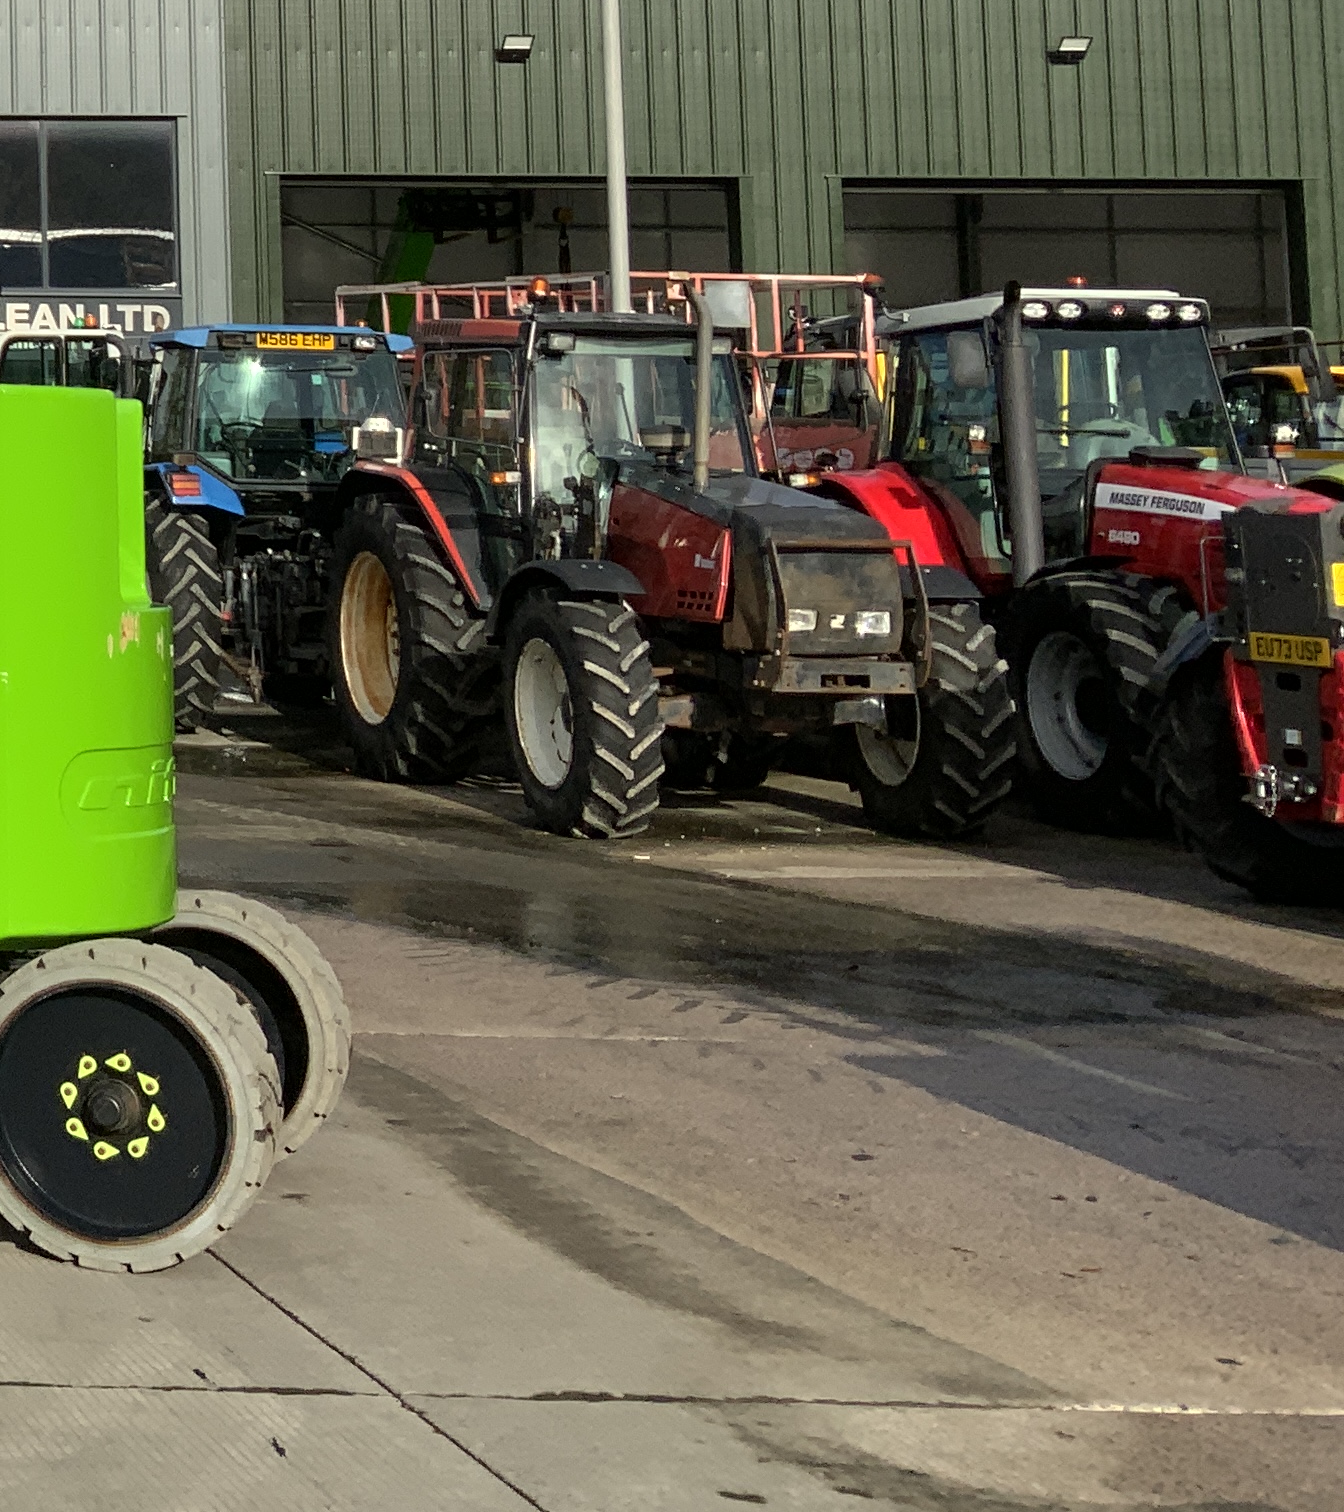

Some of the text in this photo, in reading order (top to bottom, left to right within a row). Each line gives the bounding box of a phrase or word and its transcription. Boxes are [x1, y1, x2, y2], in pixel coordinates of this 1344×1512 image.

[99, 303, 171, 333] LTD
[1109, 492, 1206, 515] MASSEY FERGUSON
